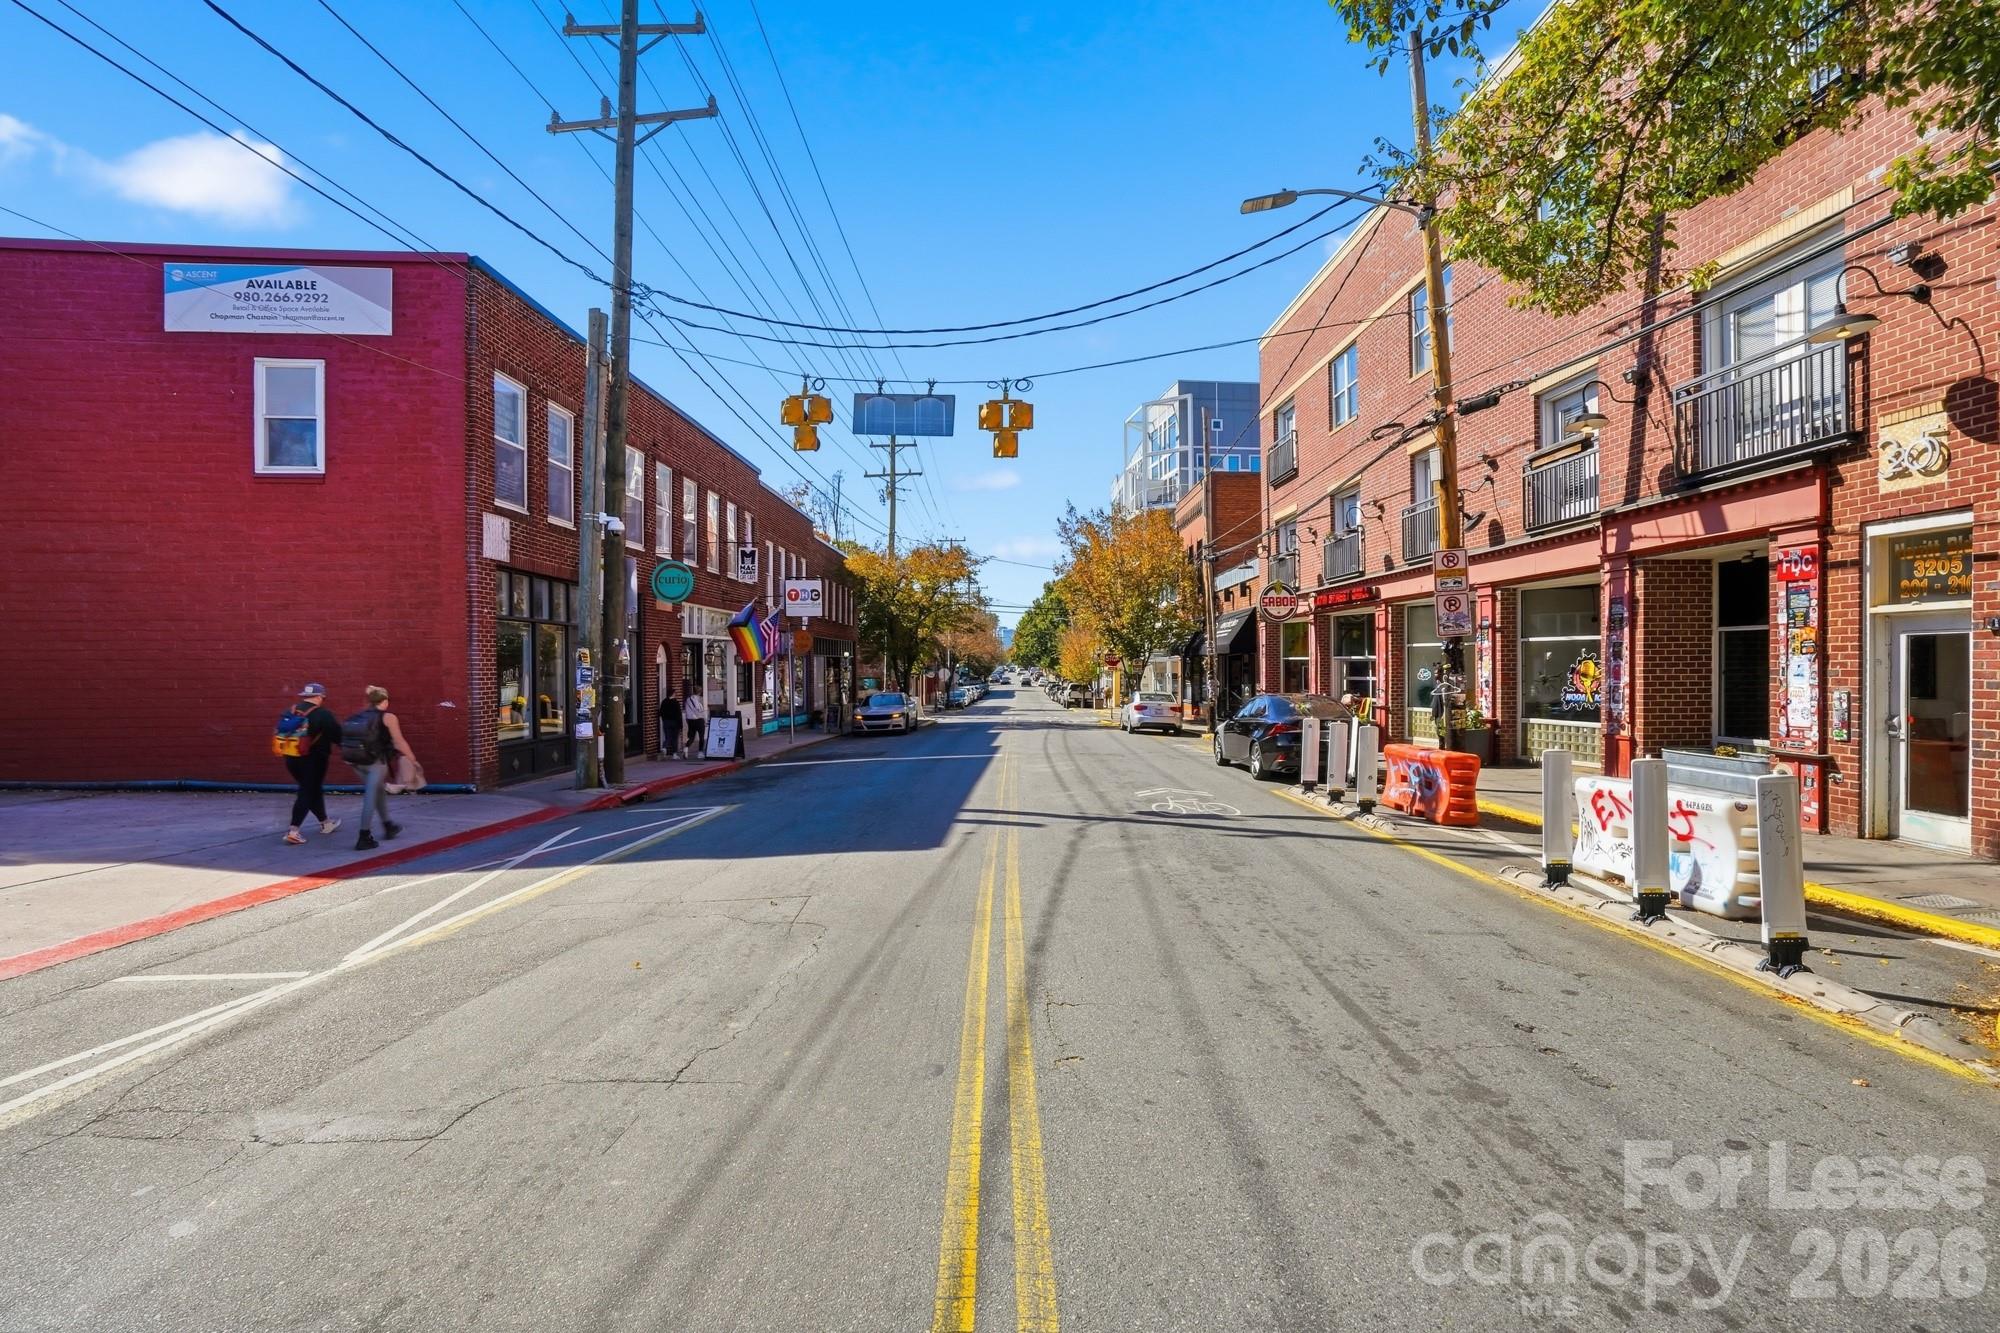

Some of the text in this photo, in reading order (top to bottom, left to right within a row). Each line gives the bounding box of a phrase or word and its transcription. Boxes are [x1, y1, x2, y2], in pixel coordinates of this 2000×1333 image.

[186, 270, 217, 279] ASCENT
[246, 279, 317, 291] AVAILABLE
[233, 291, 329, 304] 980.266.9292
[209, 312, 245, 322] Chapman
[246, 313, 278, 321] Chastain
[1913, 554, 1963, 578] 3205
[1900, 578, 1928, 598] 201
[1262, 596, 1296, 608] SABOR
